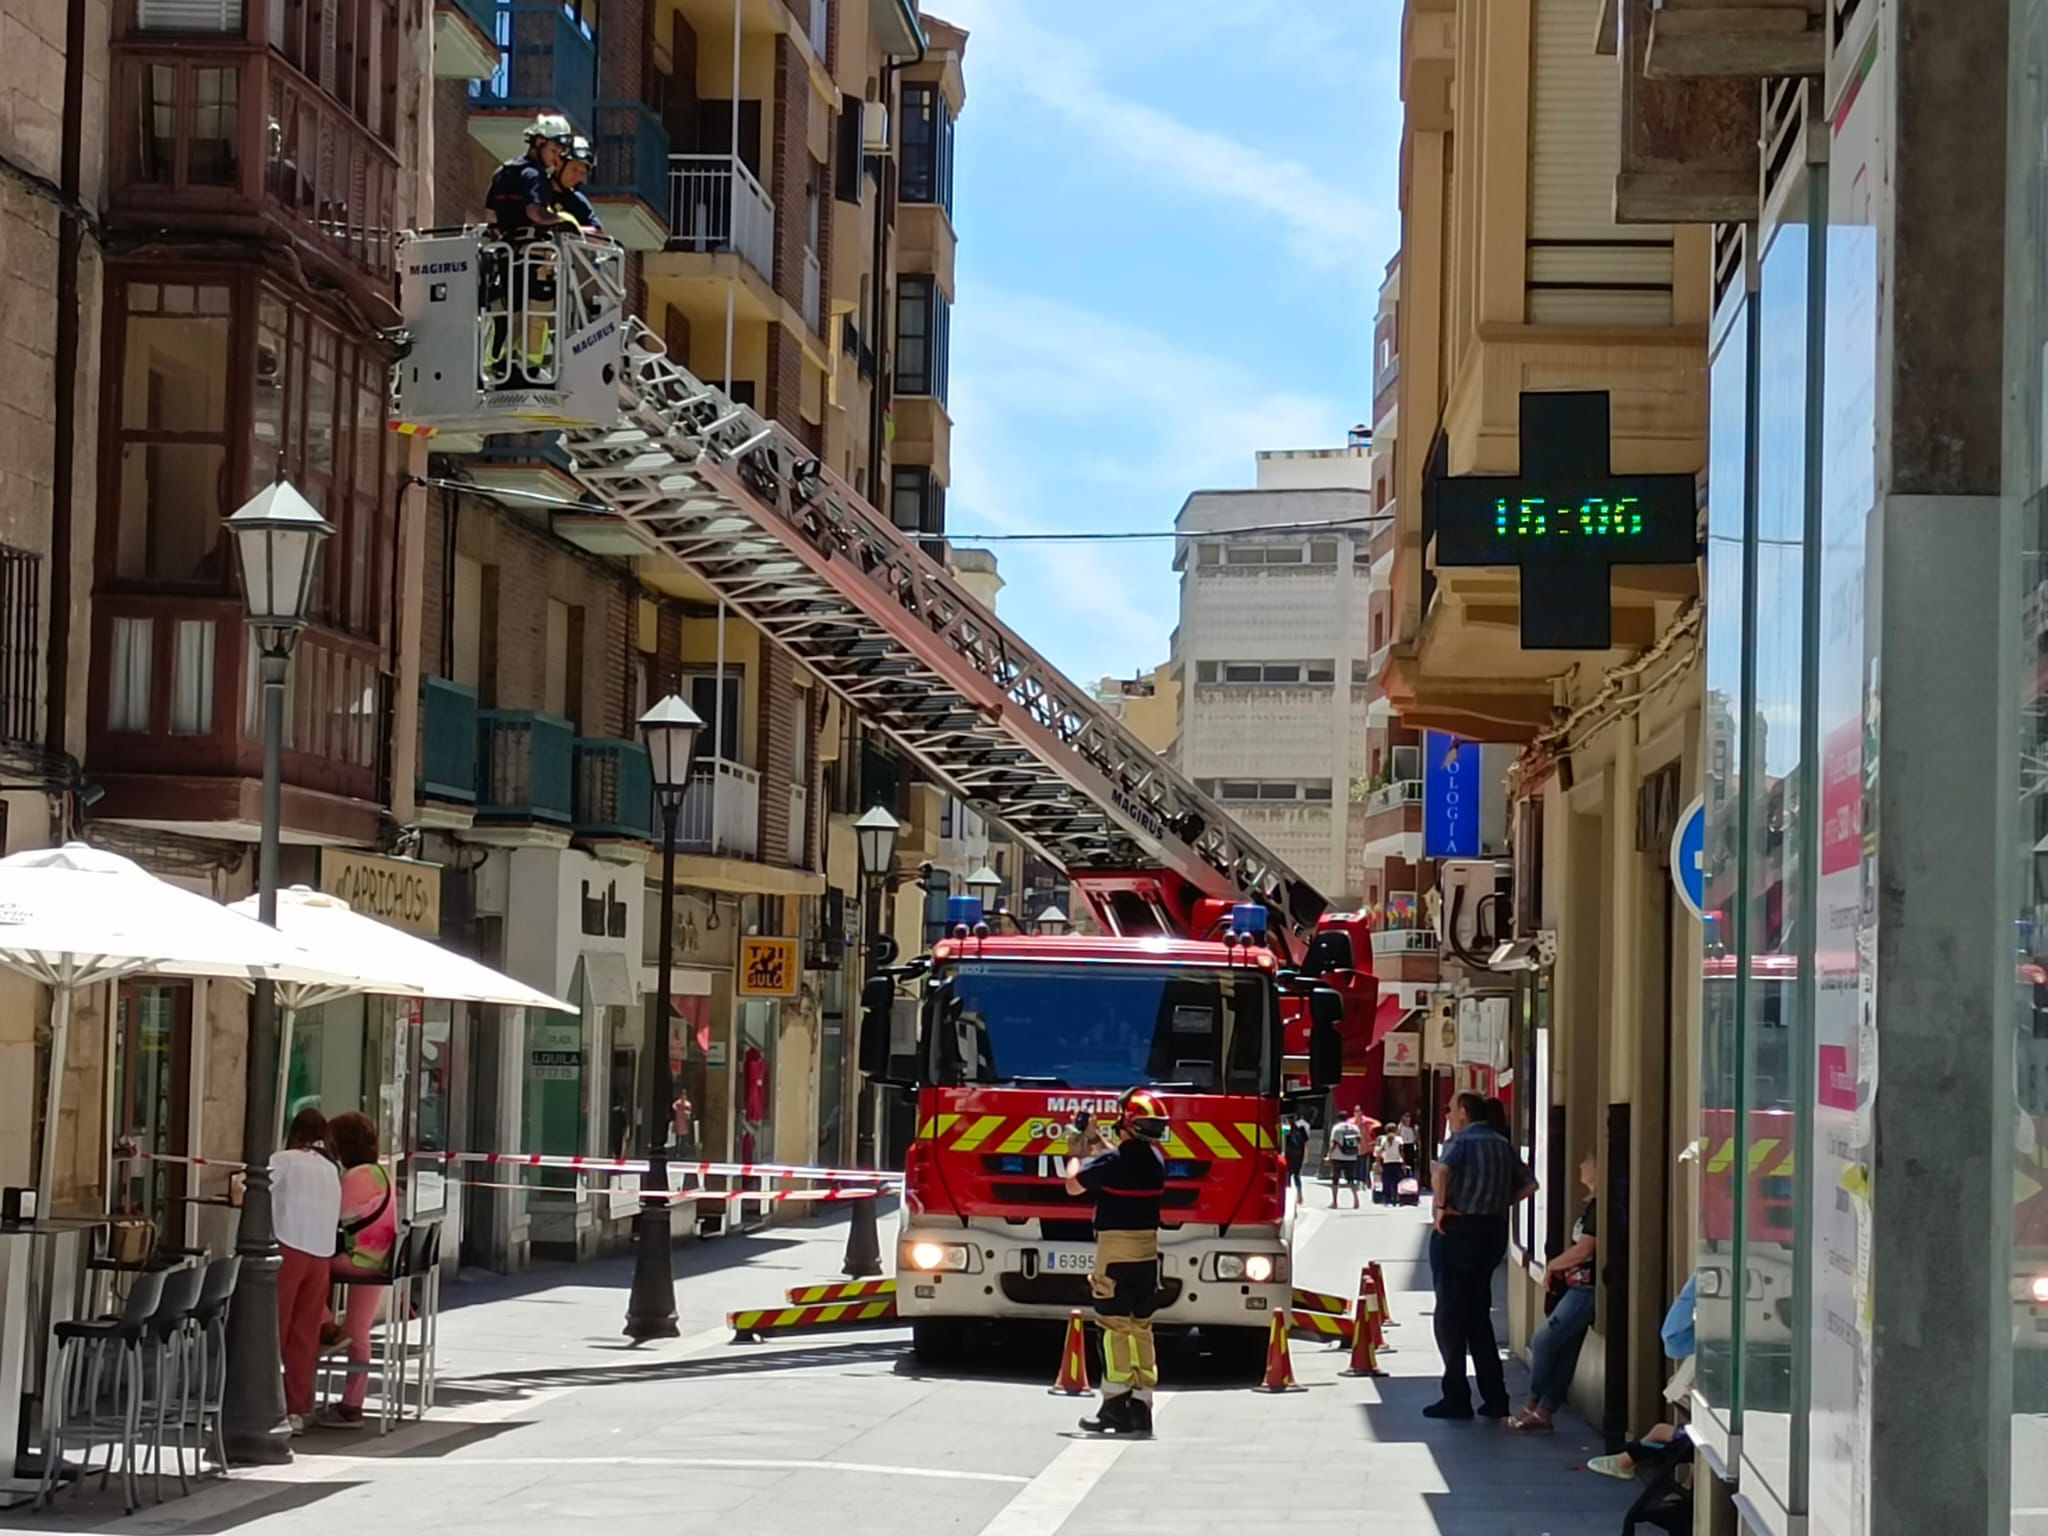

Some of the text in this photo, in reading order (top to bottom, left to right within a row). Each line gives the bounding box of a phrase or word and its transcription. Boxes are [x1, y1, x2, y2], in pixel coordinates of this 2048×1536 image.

[409, 261, 468, 275] MAGIRUS
[572, 322, 616, 355] MAGIRUS
[1111, 789, 1164, 840] MAGIRUS
[534, 1053, 578, 1065] LQUILA
[1047, 1097, 1123, 1113] MAGIR
[1059, 1254, 1096, 1269] 6395
